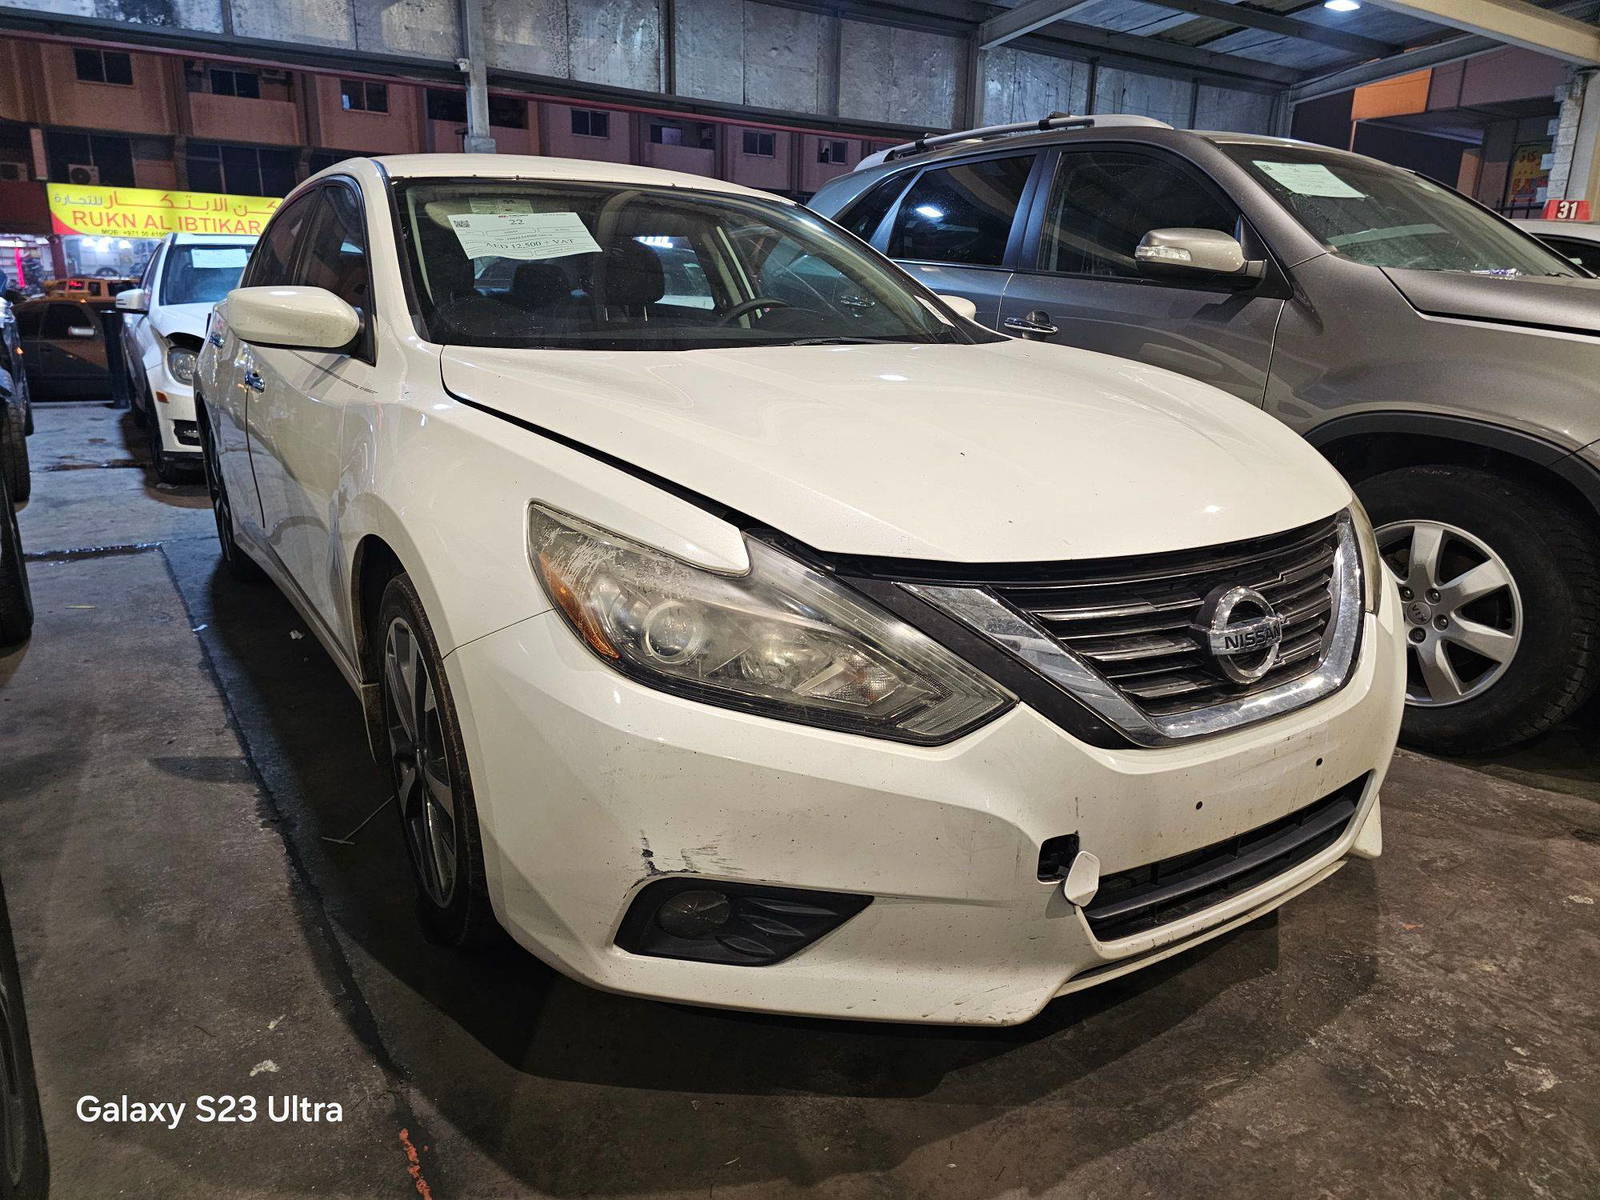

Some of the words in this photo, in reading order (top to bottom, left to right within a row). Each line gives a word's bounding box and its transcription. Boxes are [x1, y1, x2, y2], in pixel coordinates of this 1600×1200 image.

[105, 191, 229, 214] الابتكار
[233, 200, 277, 216] كن
[1557, 201, 1578, 219] 31
[72, 210, 136, 228] RUKN
[144, 215, 172, 230] AL
[177, 217, 261, 234] IBTIKAR
[1224, 624, 1281, 649] NISSAN
